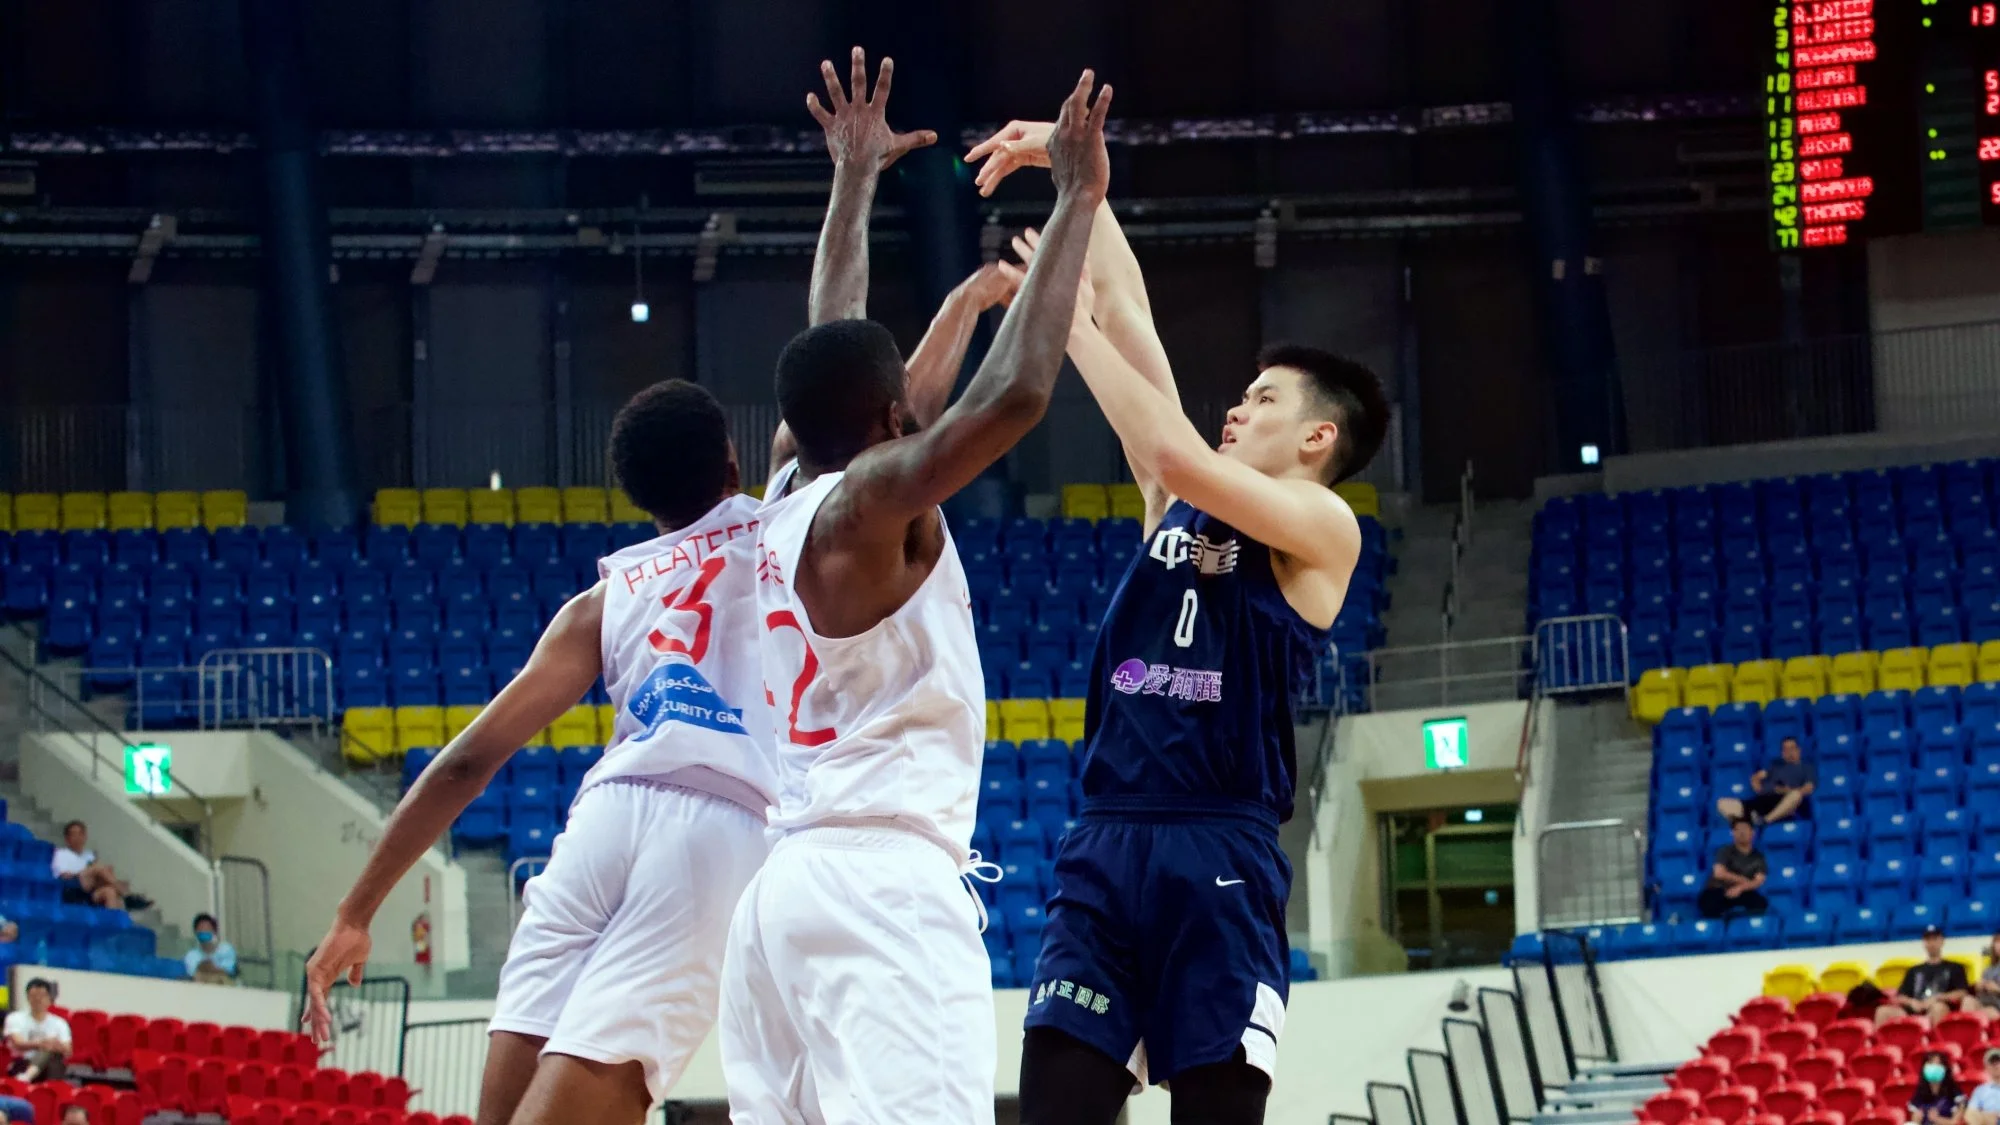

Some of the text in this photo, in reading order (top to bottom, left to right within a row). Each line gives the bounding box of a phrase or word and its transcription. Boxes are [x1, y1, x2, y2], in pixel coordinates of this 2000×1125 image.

[1774, 7, 1788, 27] 2
[1971, 4, 1996, 26] 13
[1775, 28, 1788, 49] 3
[1776, 51, 1789, 69] 4
[1767, 73, 1790, 93] 10
[1985, 70, 1999, 91] 5
[1768, 95, 1791, 115] 11
[1986, 93, 2000, 114] 2
[1769, 118, 1793, 138] 13
[1770, 139, 1793, 160] 15
[1772, 162, 1795, 183] 23
[648, 556, 726, 665] 3
[1174, 589, 1198, 648] 0
[1142, 664, 1223, 702] 愛爾麗
